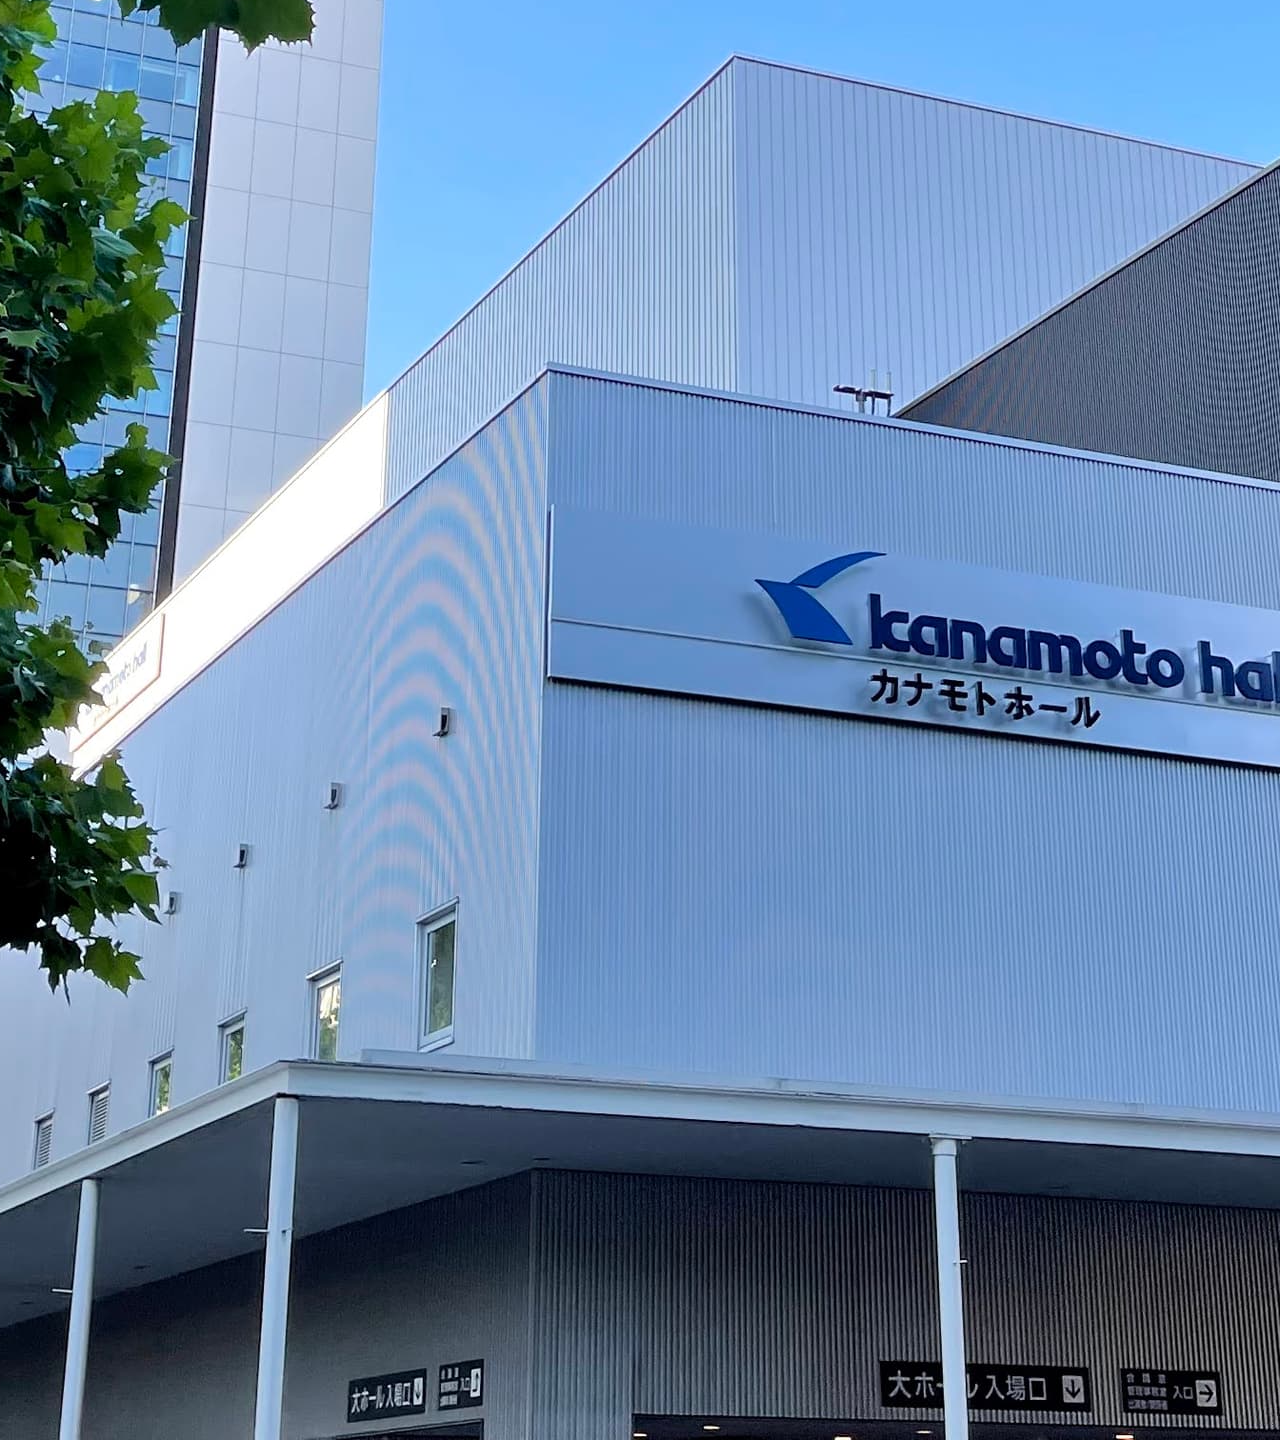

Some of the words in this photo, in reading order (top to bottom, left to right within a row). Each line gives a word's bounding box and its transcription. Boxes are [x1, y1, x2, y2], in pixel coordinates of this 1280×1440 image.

[868, 593, 1185, 688] kanamoto
[869, 668, 1101, 729] カナモトホール
[1172, 1384, 1194, 1400] 入口
